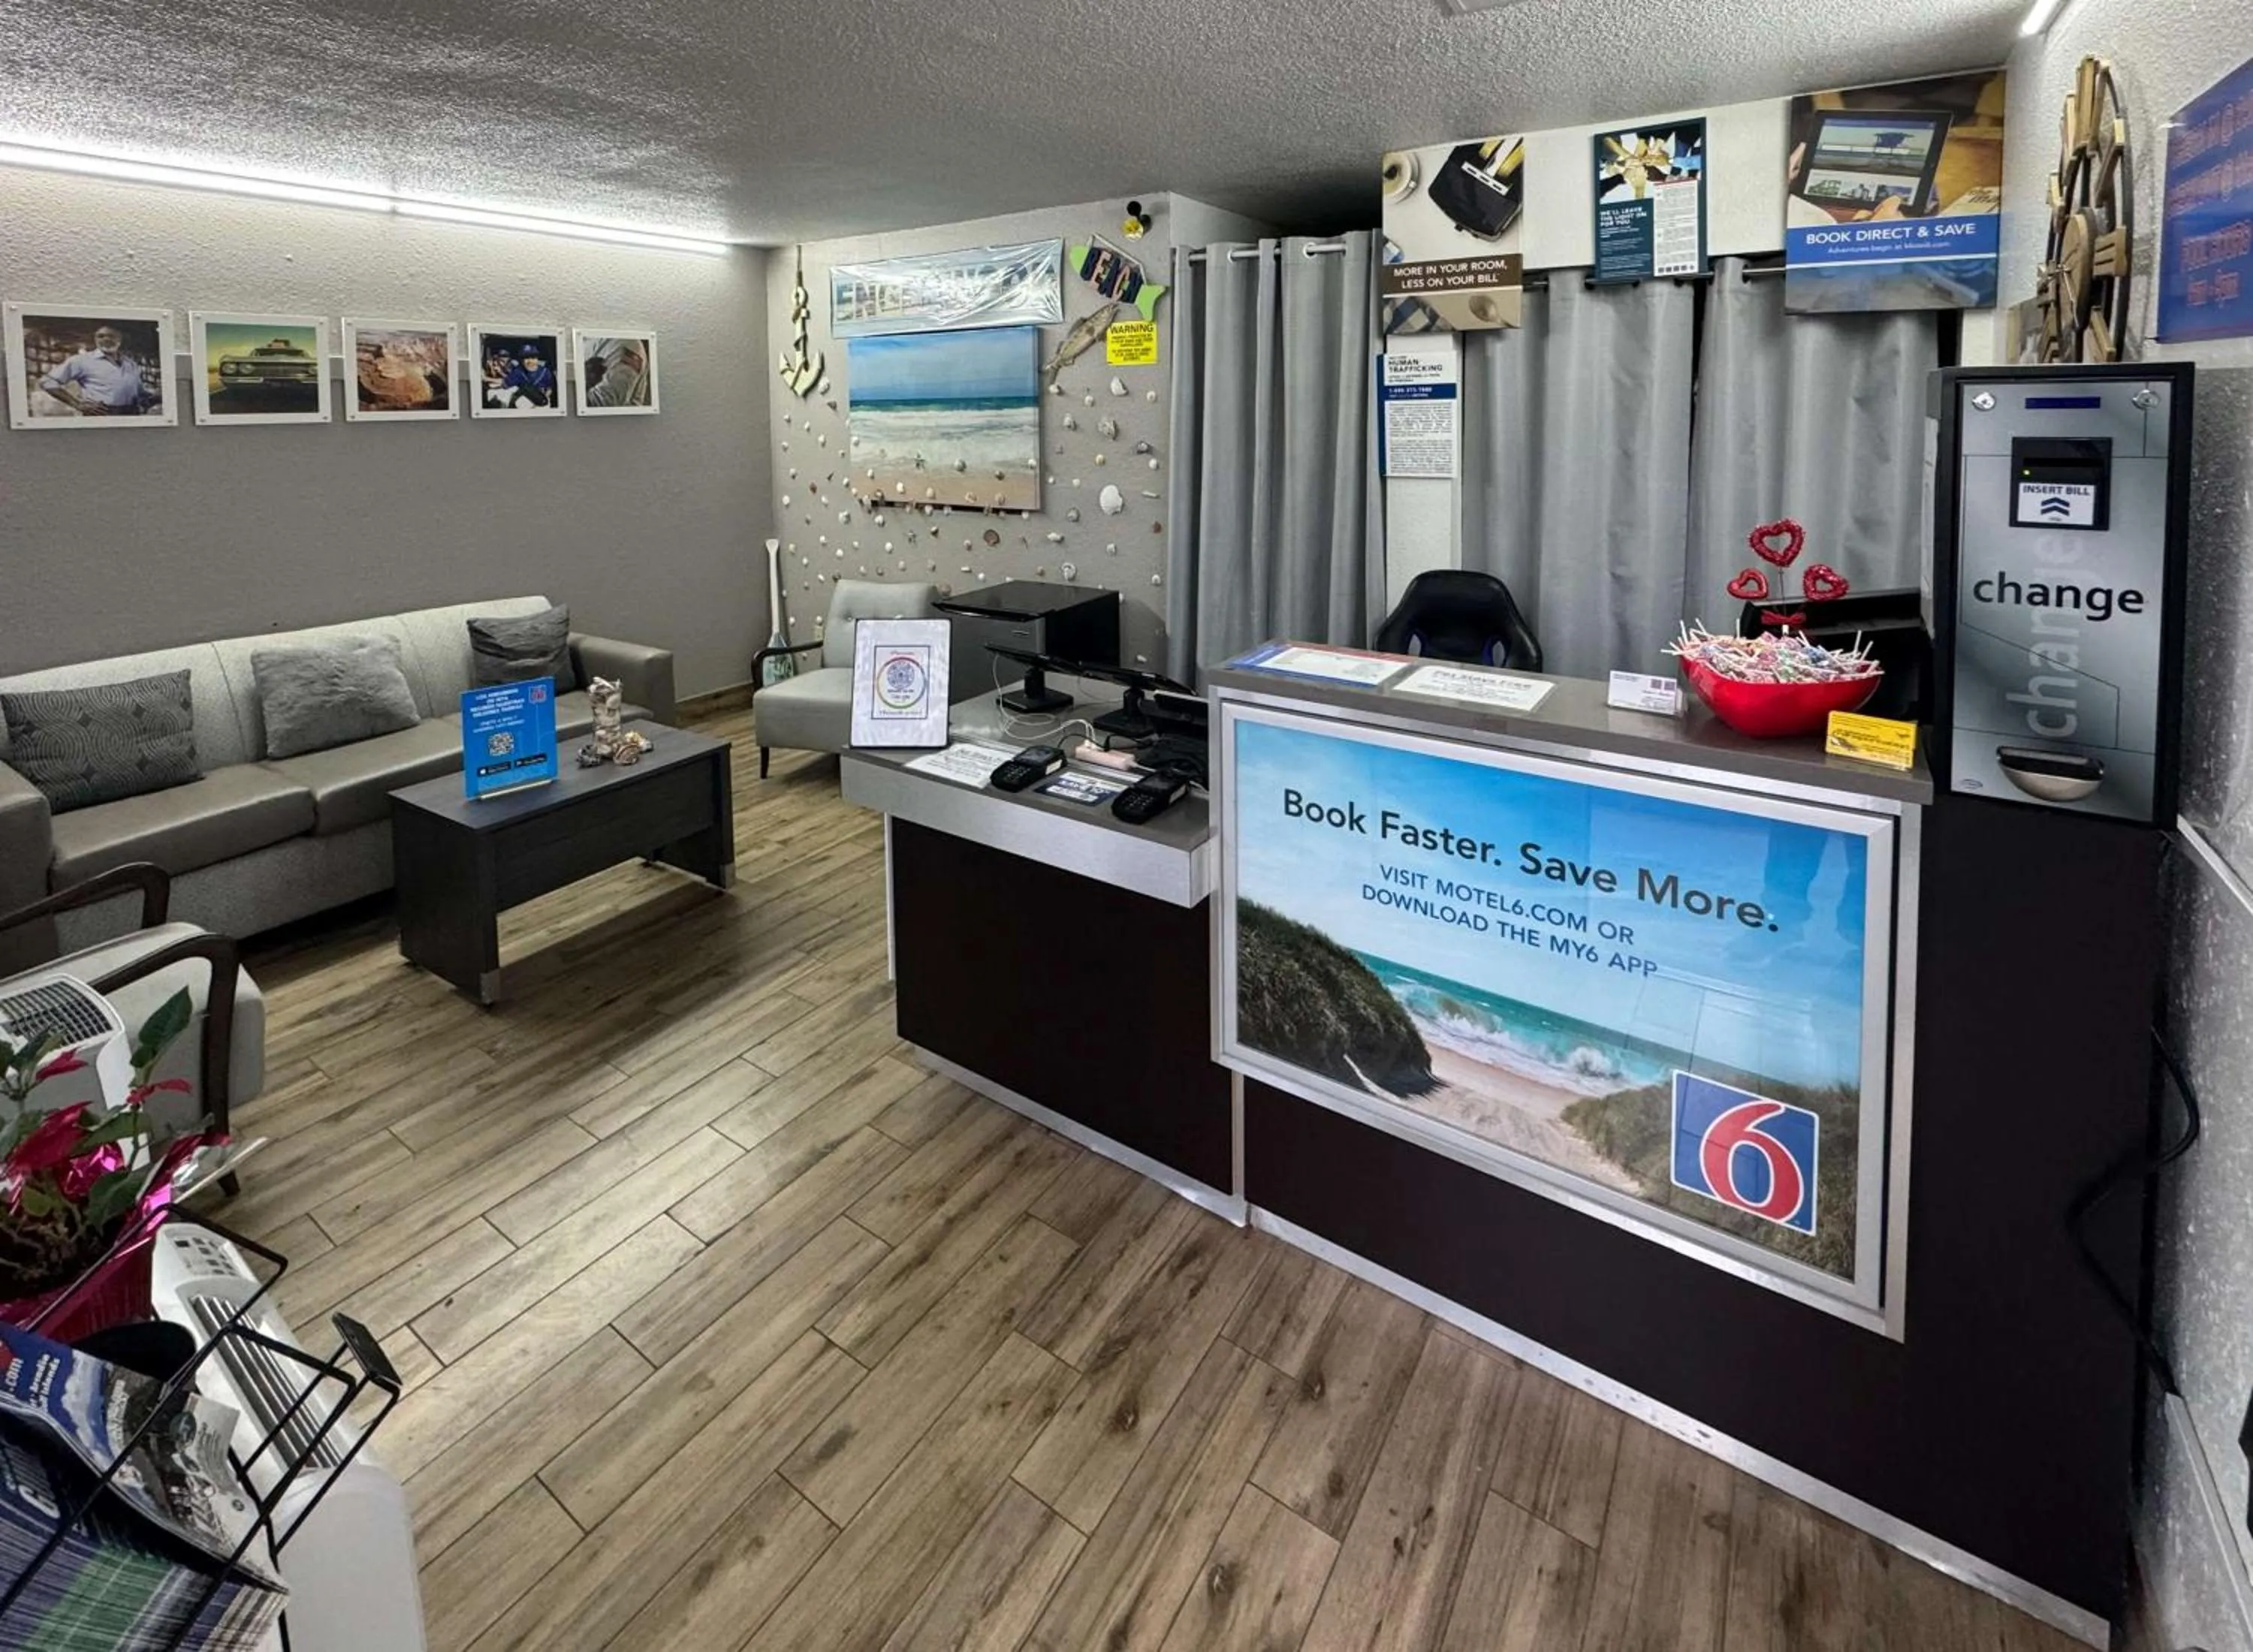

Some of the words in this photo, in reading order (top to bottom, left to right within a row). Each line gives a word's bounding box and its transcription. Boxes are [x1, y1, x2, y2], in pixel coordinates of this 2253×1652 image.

[1806, 231, 1851, 245] BOOK
[1856, 227, 1911, 242] DIRECT
[1917, 226, 1929, 237] &
[1934, 223, 1977, 236] SAVE
[1080, 247, 1145, 304] BEACH
[1393, 267, 1423, 277] MORE
[1427, 265, 1437, 275] IN
[1440, 263, 1469, 273] YOUR
[1471, 260, 1508, 271] ROOM,
[1401, 278, 1425, 289] LESS
[1427, 277, 1443, 287] ON
[1446, 275, 1474, 285] YOUR
[1477, 273, 1498, 284] BILL
[1111, 324, 1154, 334] WARNING
[1389, 364, 1443, 373] TRAFFICKING
[2022, 485, 2064, 494] INSERT
[2066, 486, 2091, 496] BILL
[1973, 571, 2144, 621] change
[1284, 788, 1366, 834] Book
[1381, 810, 1502, 866] Faster.
[1519, 842, 1617, 893] Save
[1638, 867, 1779, 932] More.
[1380, 864, 1428, 890] VISIT
[1436, 878, 1588, 933] MOTEL6.COM
[1598, 921, 1634, 945] OR
[1362, 884, 1488, 932] DOWNLOAD
[1497, 921, 1540, 948] THE
[1549, 935, 1599, 963] MY6
[1608, 951, 1657, 977] APP
[1699, 1099, 1804, 1225] 6
